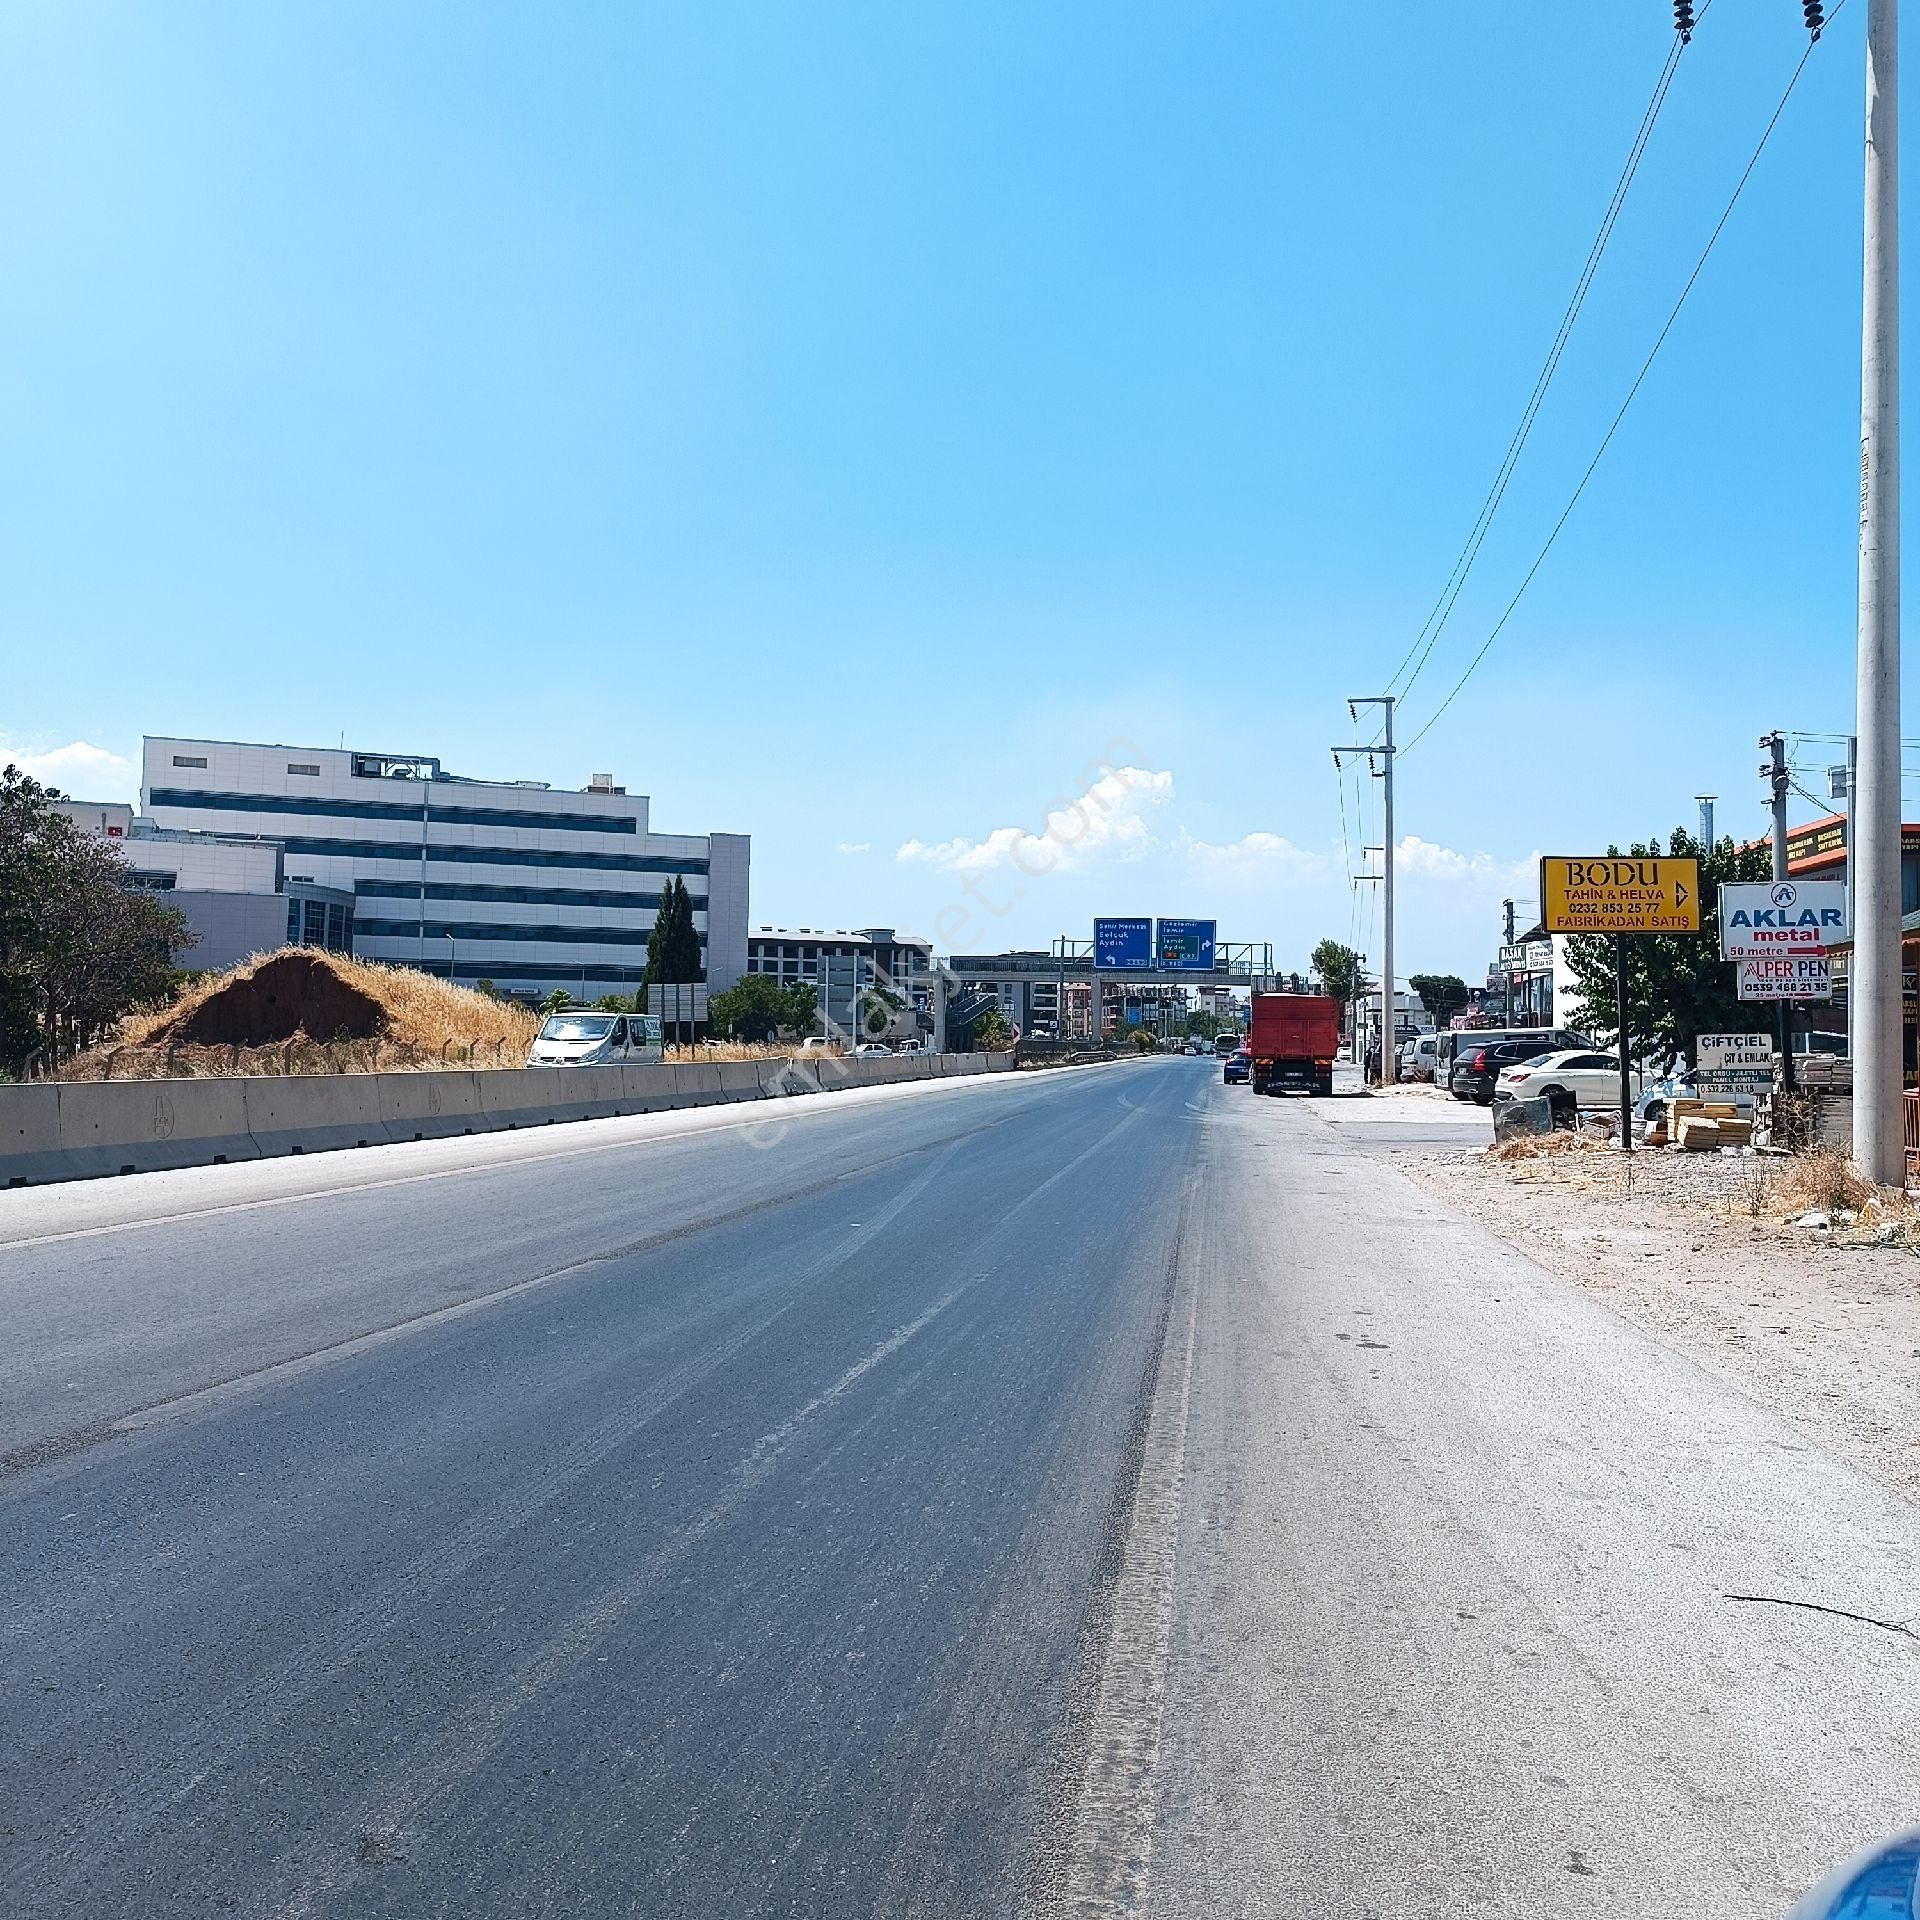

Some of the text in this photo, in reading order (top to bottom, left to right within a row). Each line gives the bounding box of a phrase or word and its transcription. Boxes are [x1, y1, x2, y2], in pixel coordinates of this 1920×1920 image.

[1565, 862, 1659, 886] BODU
[1564, 888, 1665, 900] TAHİN & HELVA
[1568, 903, 1660, 914] 0232 853 25 77
[1557, 914, 1689, 929] FABRİKADAN SATIŞ
[1729, 909, 1844, 927] AKLAR
[1753, 928, 1820, 942] metal
[1730, 947, 1783, 956] 50 metre
[1744, 961, 1793, 979] ALPER
[1798, 961, 1829, 977] PEN
[1744, 983, 1828, 992] 0539 488 21 35
[1701, 1036, 1766, 1050] ÇİFTÇİEL
[1724, 1053, 1770, 1066] ÇİT & EMLAK
